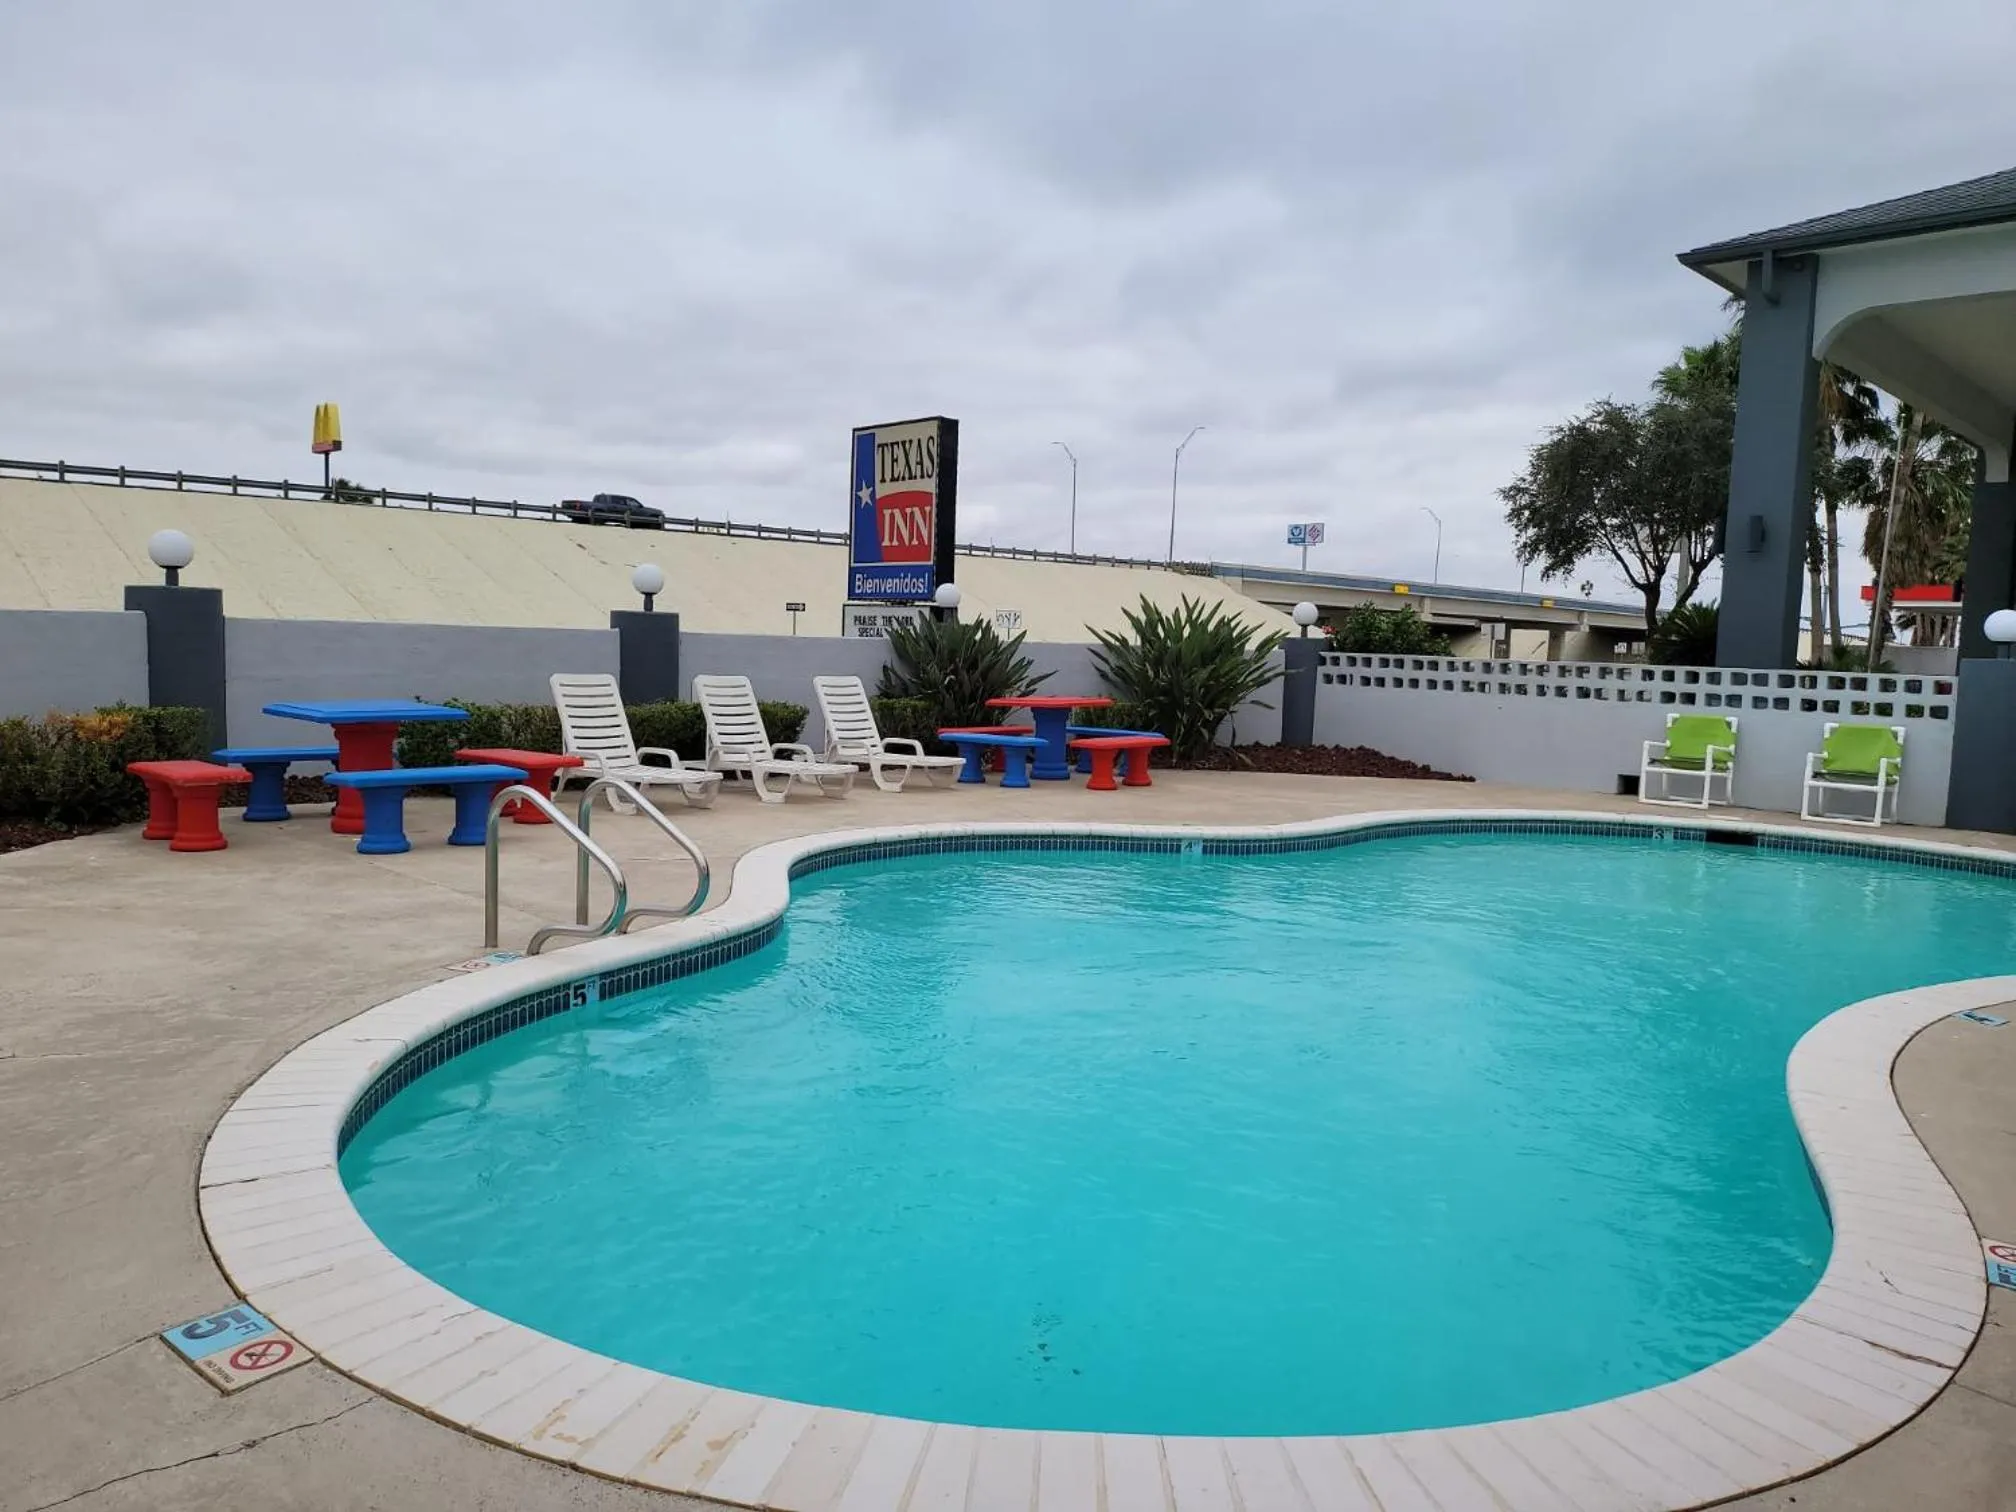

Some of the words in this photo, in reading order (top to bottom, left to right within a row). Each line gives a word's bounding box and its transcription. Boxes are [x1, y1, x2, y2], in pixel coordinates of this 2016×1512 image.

[878, 435, 935, 483] TEXAS
[882, 506, 931, 546] INN
[855, 572, 929, 594] Bienvenidos!
[853, 615, 877, 627] PRAISE
[858, 627, 884, 638] SPECIAL
[572, 983, 587, 1008] 5
[181, 1309, 250, 1340] 5
[234, 1320, 264, 1336] FT
